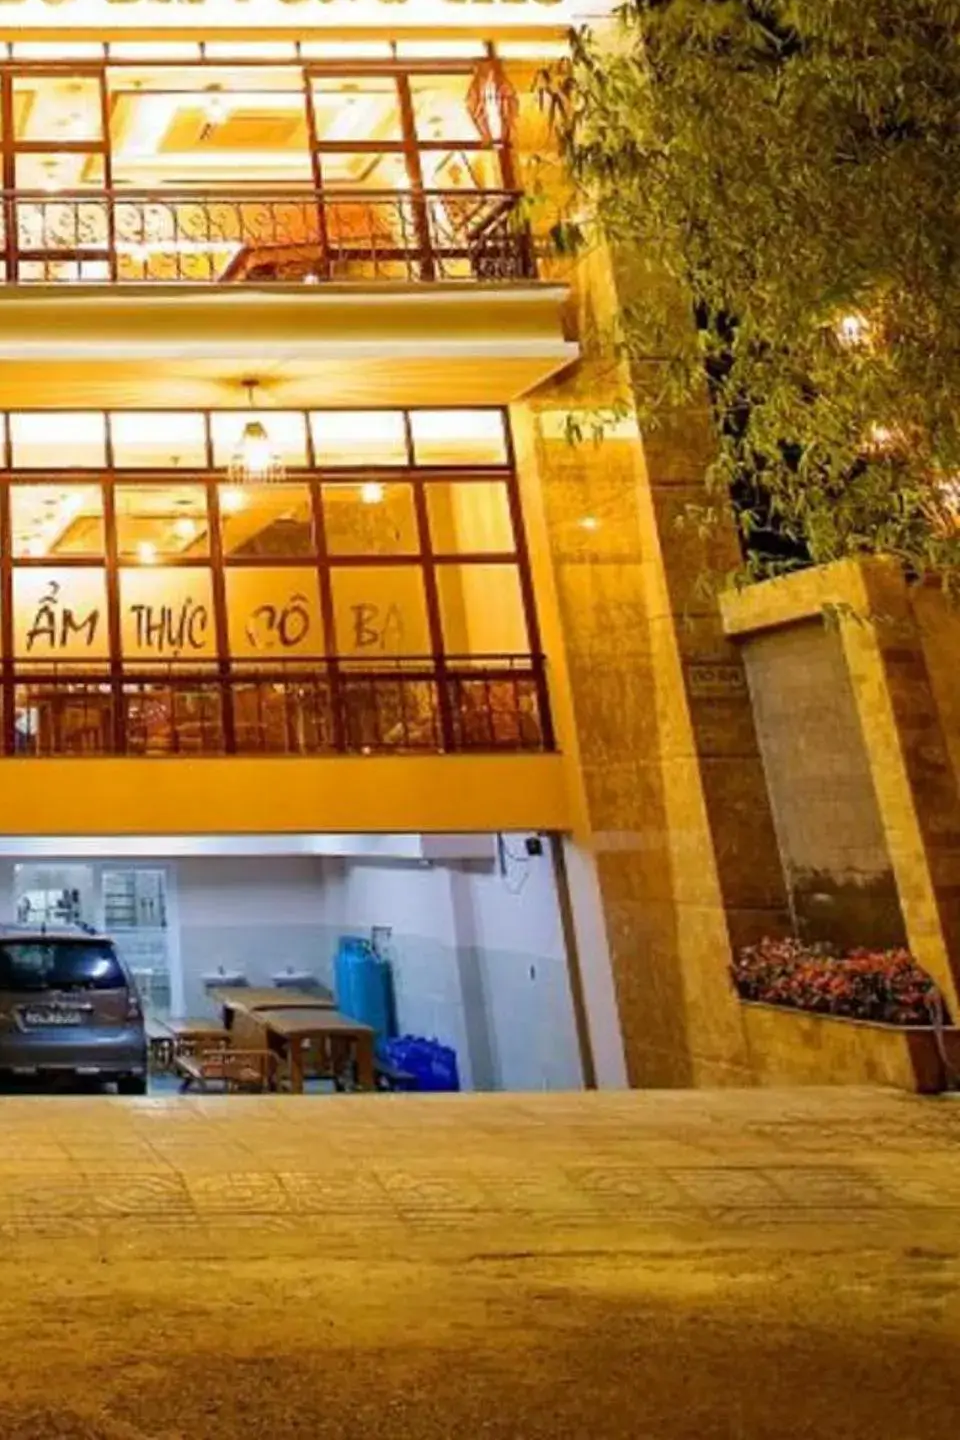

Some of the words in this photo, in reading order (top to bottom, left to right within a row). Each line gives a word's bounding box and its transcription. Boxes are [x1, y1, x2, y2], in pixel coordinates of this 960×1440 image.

[26, 581, 101, 651] ẨM
[130, 598, 207, 657] THỰC
[247, 595, 310, 646] CÔ
[353, 602, 405, 648] BA
